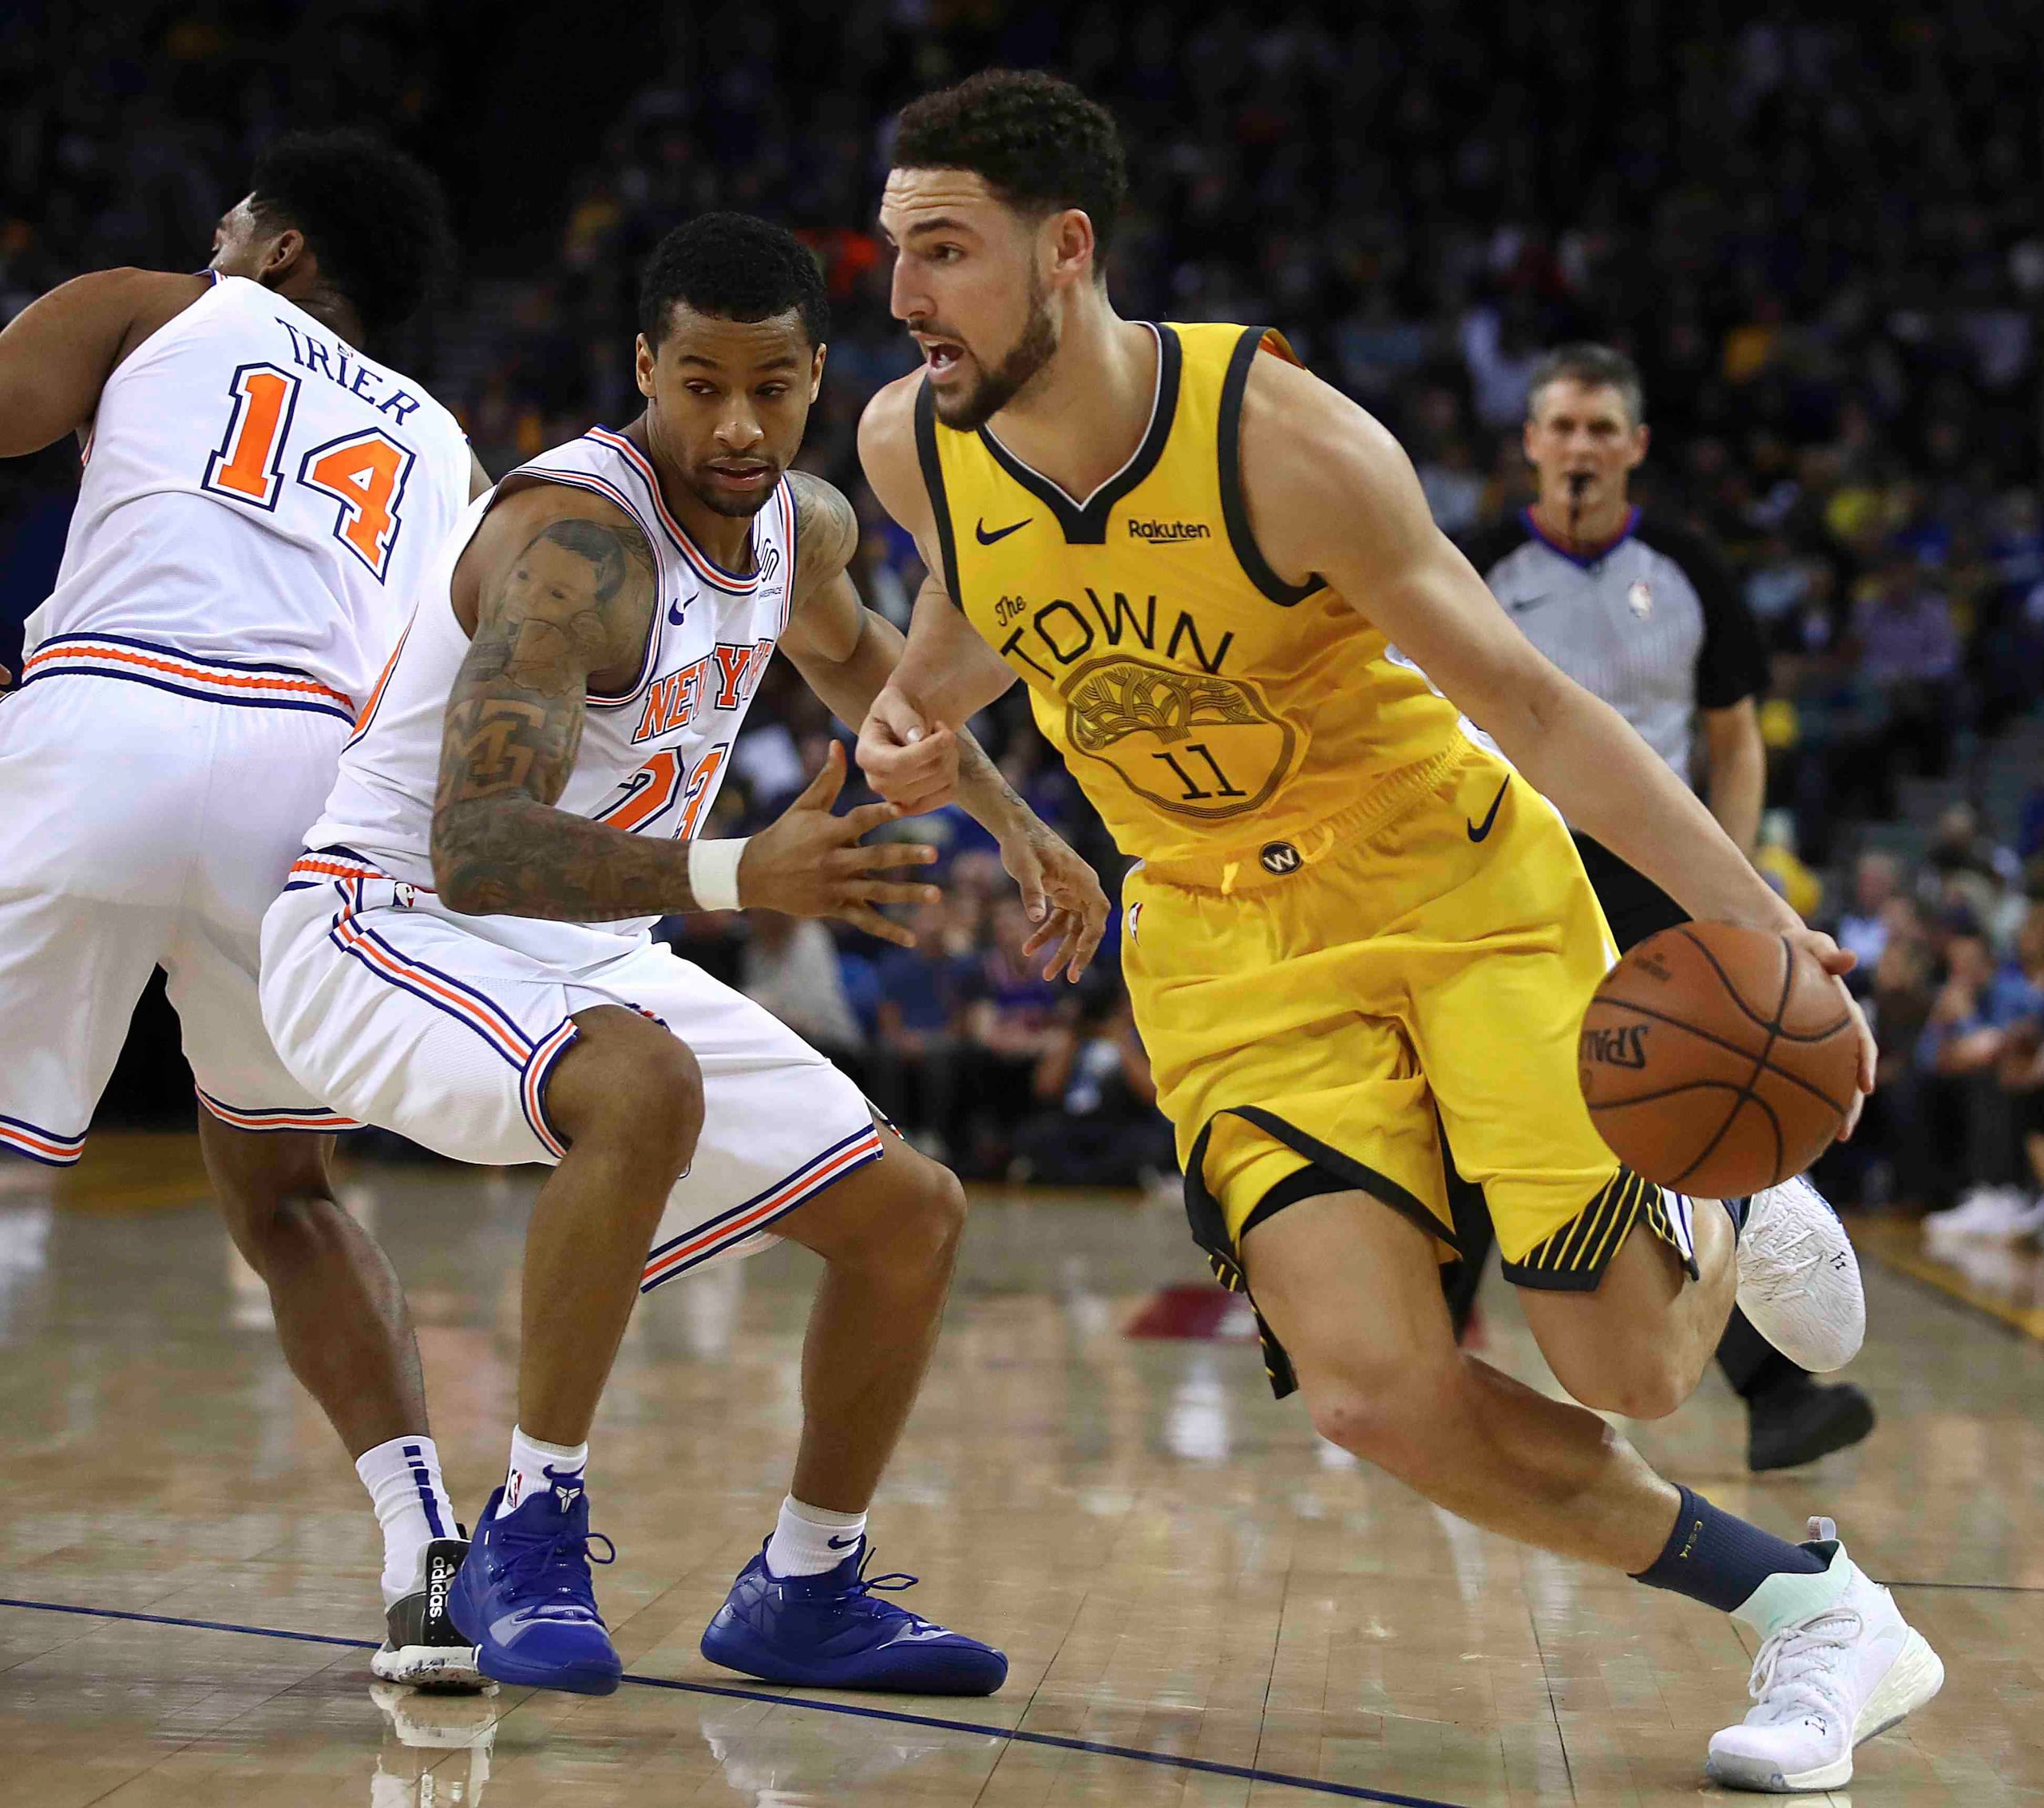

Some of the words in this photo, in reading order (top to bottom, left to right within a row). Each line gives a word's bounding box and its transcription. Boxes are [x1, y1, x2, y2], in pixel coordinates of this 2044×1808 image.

[275, 316, 420, 425] TRIER
[200, 362, 416, 586] 14
[1128, 519, 1210, 544] Rakuten
[995, 593, 1027, 626] The
[1001, 588, 1234, 680] TOWN
[1152, 744, 1246, 800] 11
[429, 1556, 447, 1618] adidas
